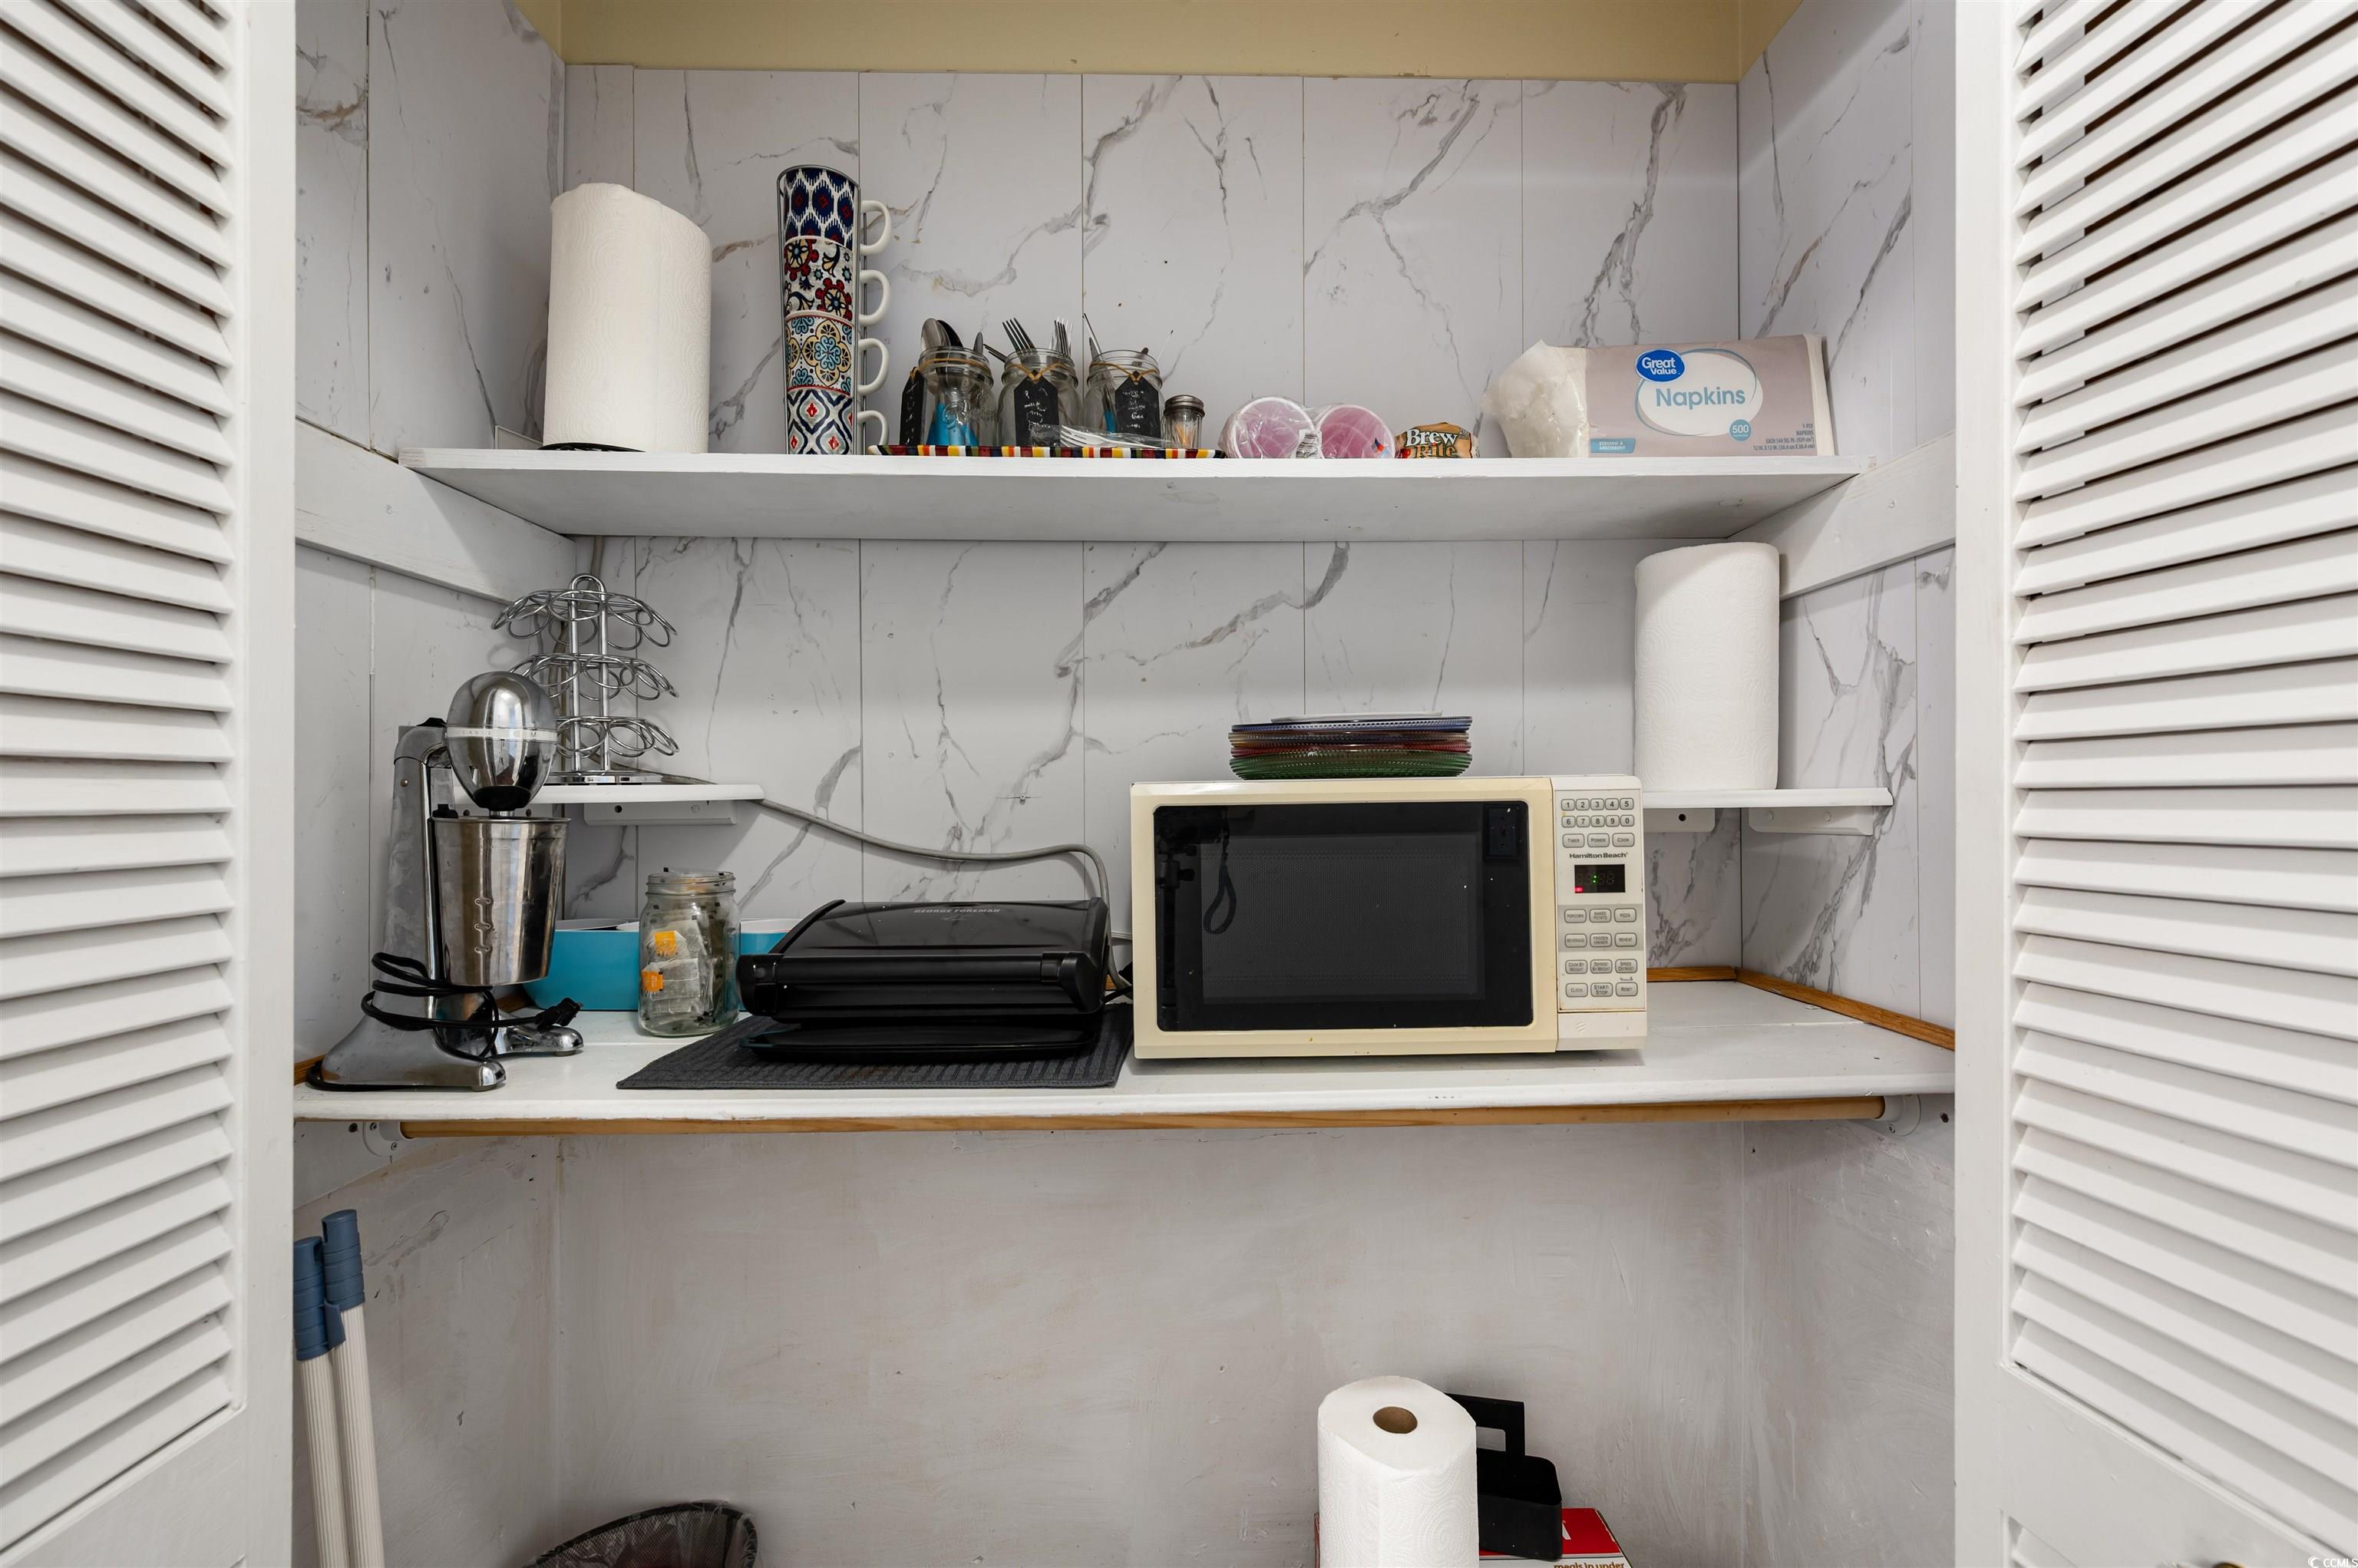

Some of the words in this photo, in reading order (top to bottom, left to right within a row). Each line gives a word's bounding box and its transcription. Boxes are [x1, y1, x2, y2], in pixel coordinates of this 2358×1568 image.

[1641, 356, 1676, 368] Great
[1650, 367, 1677, 375] Value
[1656, 386, 1745, 410] Napkins
[1732, 424, 1749, 434] 500
[1405, 429, 1458, 447] Brew
[1415, 443, 1458, 458] Rite
